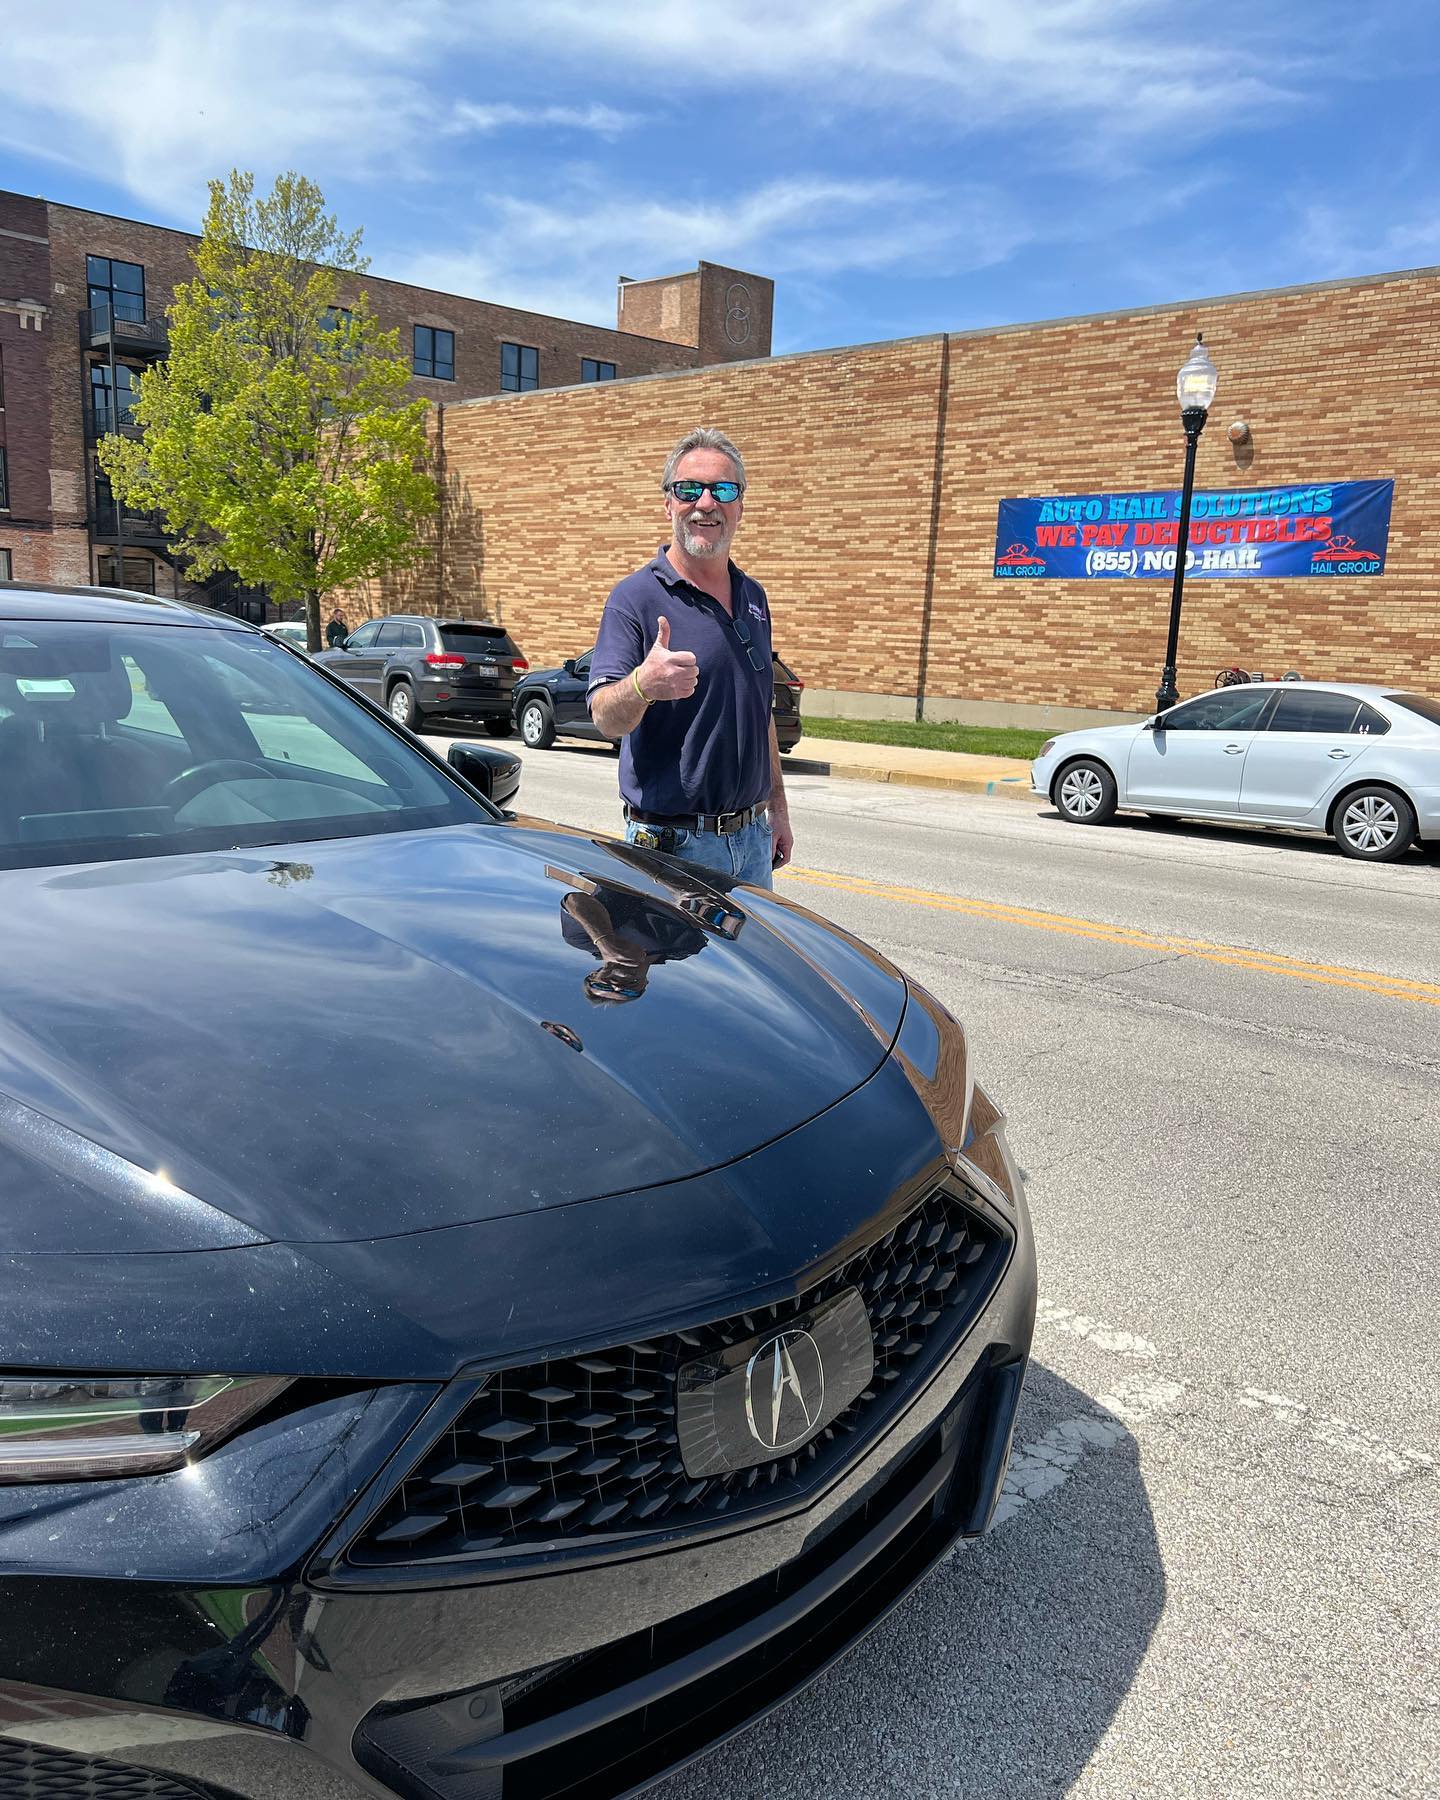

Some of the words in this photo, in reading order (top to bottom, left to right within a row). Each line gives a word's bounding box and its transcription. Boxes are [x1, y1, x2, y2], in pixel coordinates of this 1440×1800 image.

[1038, 499, 1103, 523] AUTO
[1107, 497, 1168, 520] HAIL
[1036, 525, 1077, 547] WE
[1081, 523, 1128, 547] PAY
[995, 566, 1015, 576] HAIL
[1015, 566, 1046, 576] GROUP
[1086, 549, 1138, 576] (855)
[1310, 562, 1336, 574] HAIL
[1337, 561, 1381, 574] GROUP
